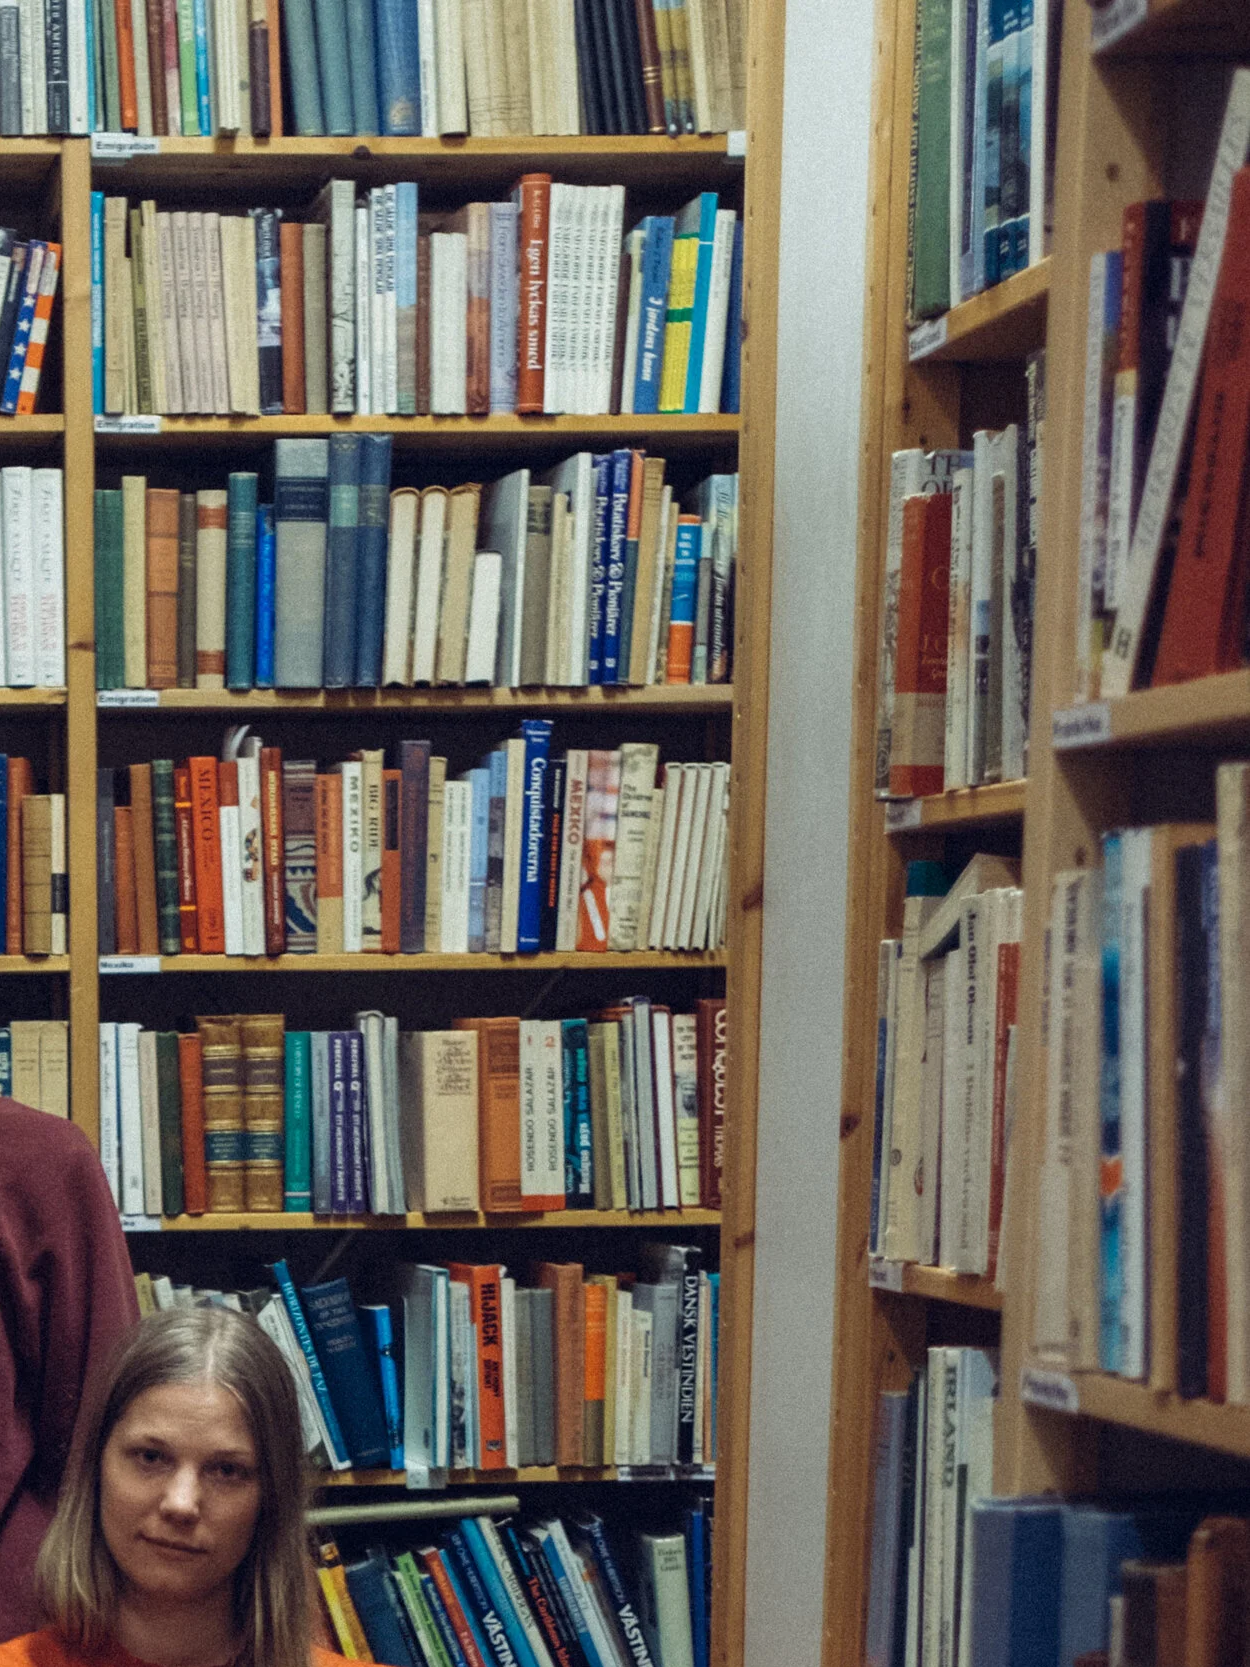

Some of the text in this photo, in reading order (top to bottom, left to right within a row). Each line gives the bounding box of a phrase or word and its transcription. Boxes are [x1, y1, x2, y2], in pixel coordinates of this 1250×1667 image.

[52, 23, 62, 75] AMERICA
[96, 141, 156, 153] Emigration
[524, 238, 544, 370] Egen lyckas smed
[644, 307, 661, 349] jordens
[95, 420, 156, 431] Emigration
[593, 496, 609, 564] Potatiskorv
[606, 493, 628, 636] Potatiskorv & Pionjärer
[590, 584, 604, 639] Pionjärer
[98, 694, 157, 705] Emigration
[198, 769, 214, 841] MEXICO
[349, 776, 359, 853] MEXIKO
[368, 784, 379, 848] BIG RIDE
[524, 757, 547, 883] Conquistadorerna
[965, 908, 978, 1045] Jan Olof Olsson
[333, 1038, 342, 1078] PERCIVAL
[350, 1038, 359, 1078] PERCIVAL
[525, 1067, 535, 1172] ROSENDO SALAZAR
[546, 1067, 557, 1172] ROSENDO SALAZAR
[282, 1281, 328, 1395] HORIZONTES DE PAZ
[480, 1282, 499, 1347] HIJACK
[680, 1275, 699, 1423] DANSK VESTINDIEN
[943, 1363, 958, 1488] IRLAND
[527, 1576, 541, 1597] The
[536, 1597, 562, 1649] Caribbean
